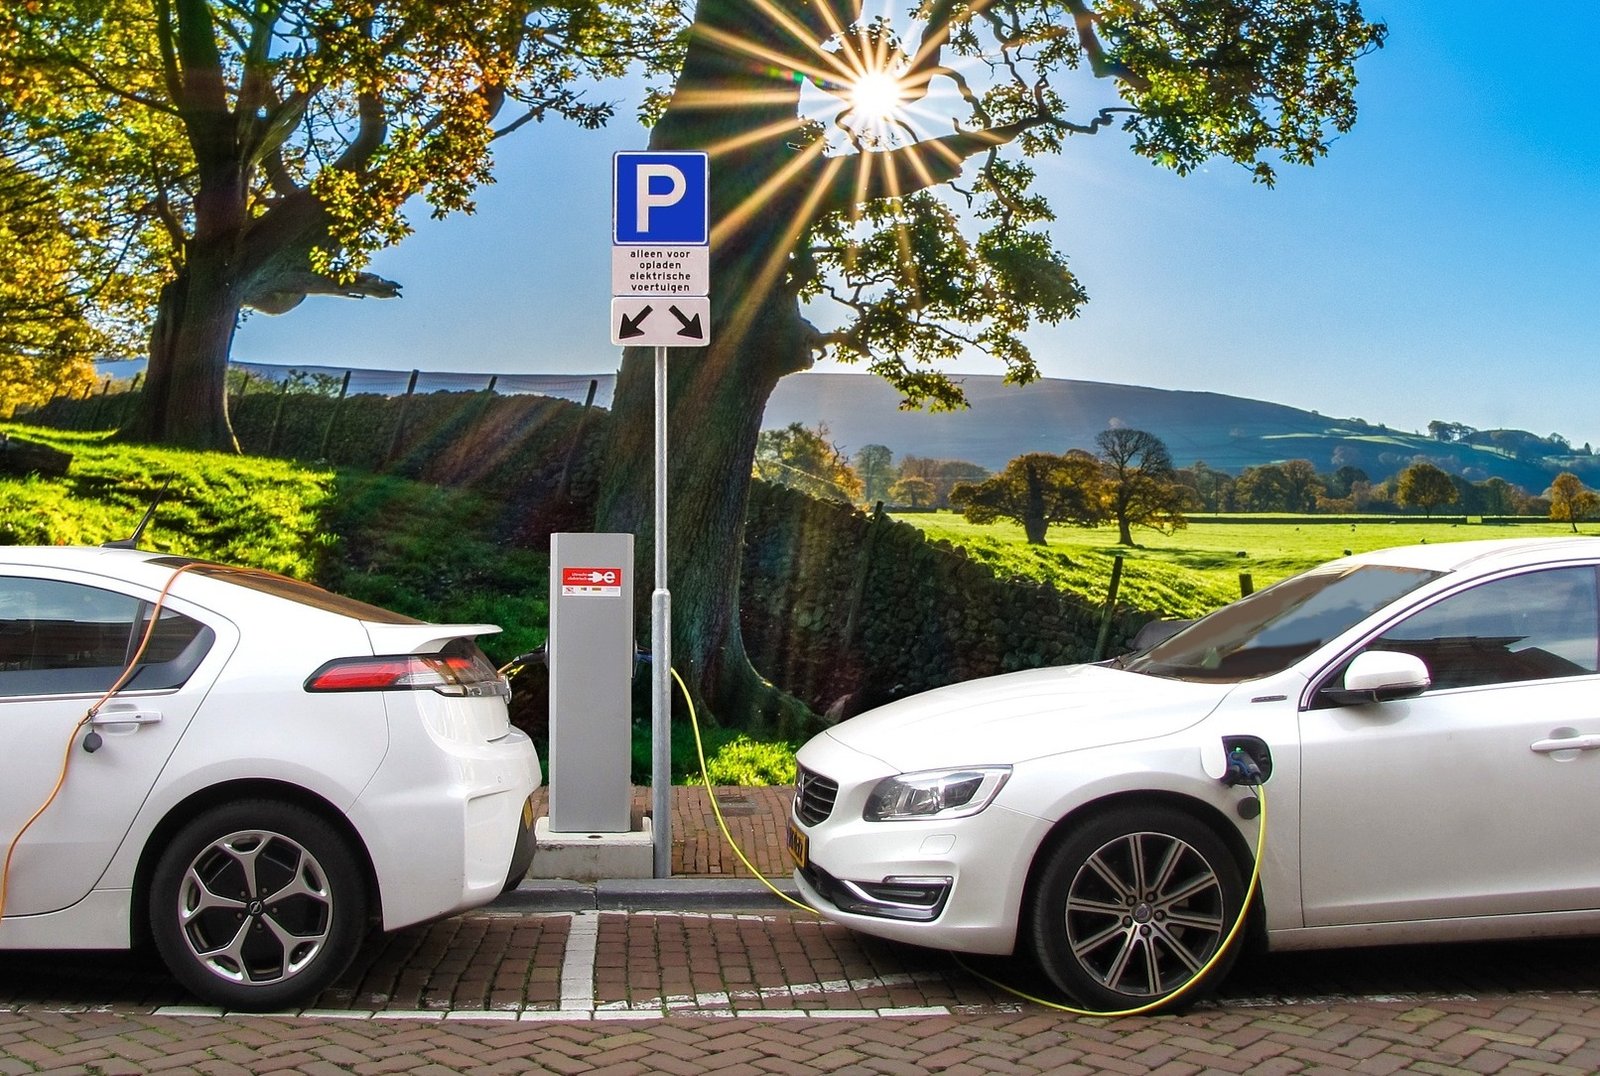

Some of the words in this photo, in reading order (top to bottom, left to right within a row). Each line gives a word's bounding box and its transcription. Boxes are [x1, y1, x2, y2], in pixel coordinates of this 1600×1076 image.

[636, 164, 687, 233] P
[630, 249, 663, 258] alleen
[639, 260, 682, 270] opladen
[629, 272, 691, 280] elektrische
[631, 283, 690, 293] voertuigen
